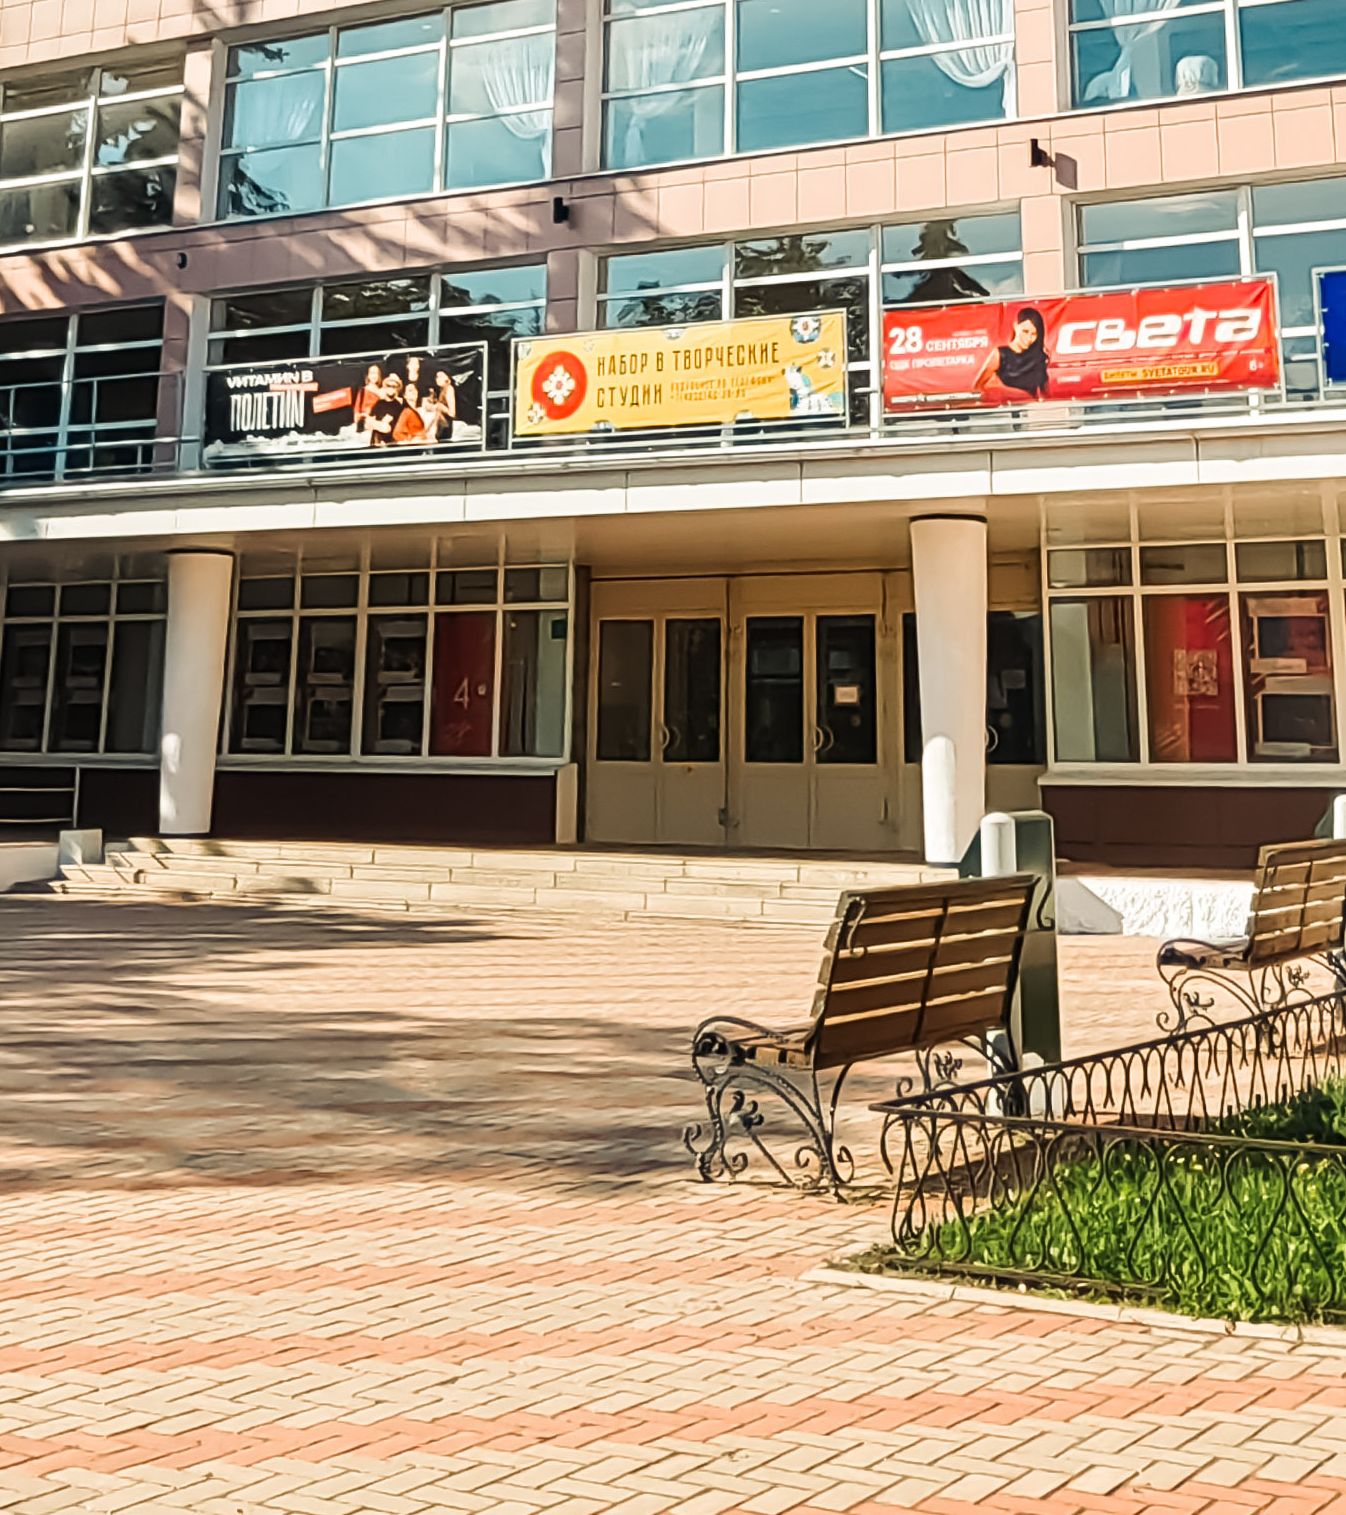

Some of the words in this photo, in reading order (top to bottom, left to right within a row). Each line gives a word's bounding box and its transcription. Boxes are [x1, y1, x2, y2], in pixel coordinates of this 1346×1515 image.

[889, 326, 923, 354] 28
[925, 335, 988, 352] СЕНТЯБРЯ
[597, 353, 648, 377] НАБОР
[656, 351, 664, 372] В
[672, 341, 780, 371] ТВОРЧЕСКИЕ
[597, 384, 662, 408] СТУДИИ
